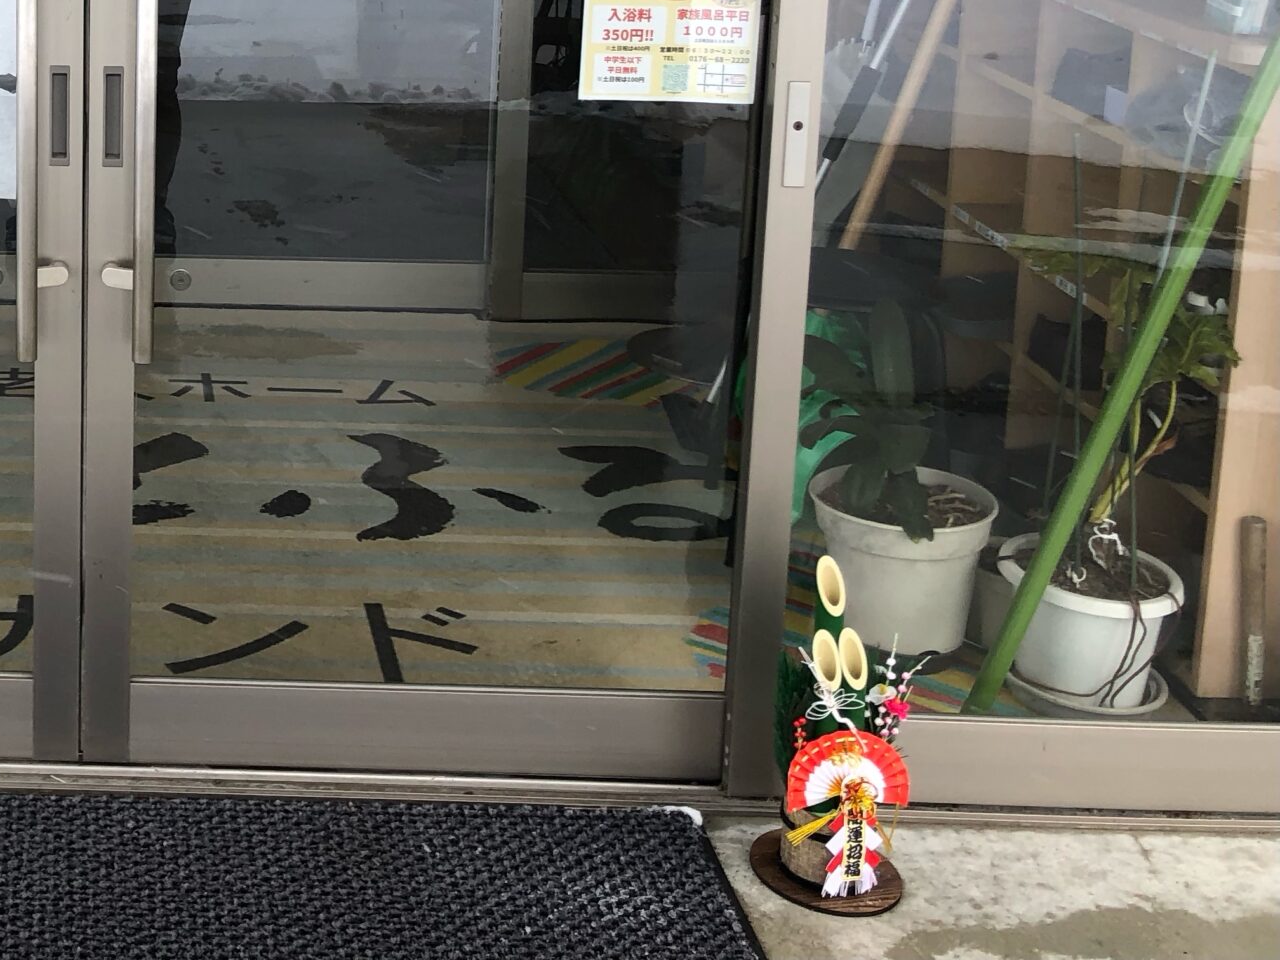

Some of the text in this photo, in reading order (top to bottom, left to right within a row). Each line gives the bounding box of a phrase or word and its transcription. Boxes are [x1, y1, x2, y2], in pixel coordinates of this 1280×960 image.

[608, 8, 653, 22] 入浴料
[677, 8, 750, 22] 家族風呂平日
